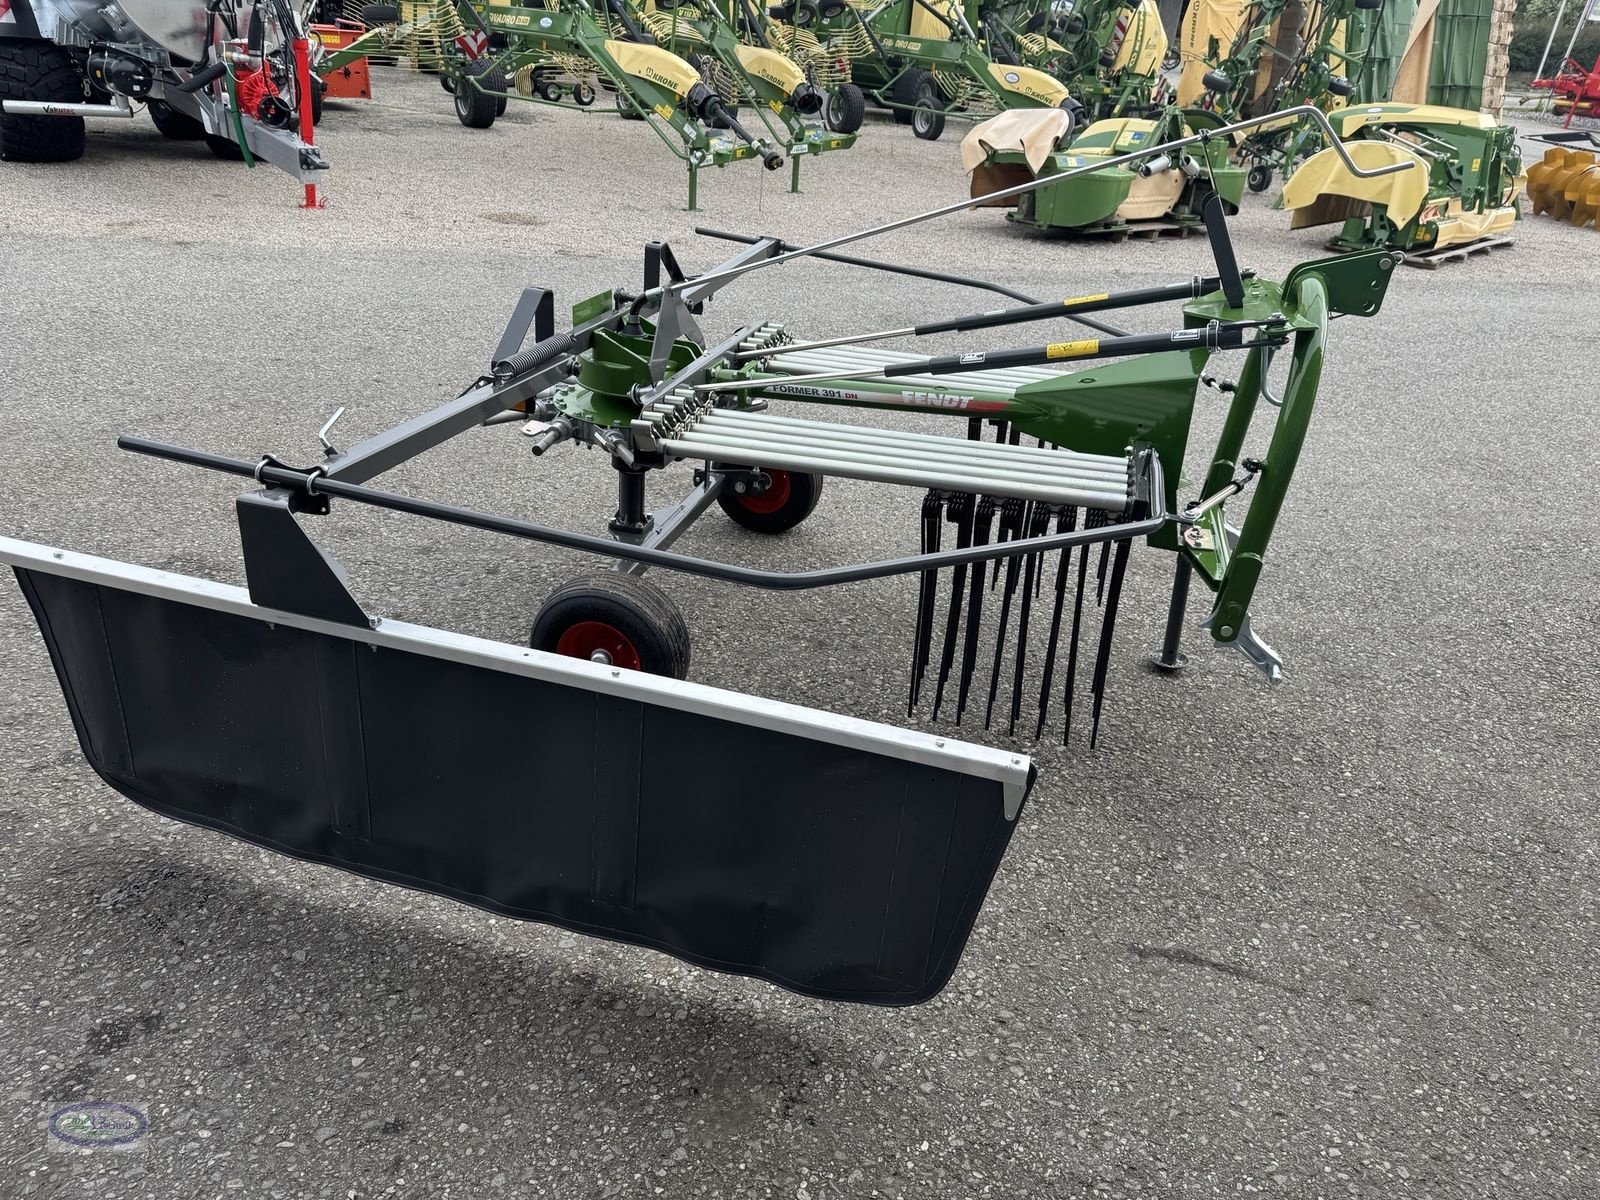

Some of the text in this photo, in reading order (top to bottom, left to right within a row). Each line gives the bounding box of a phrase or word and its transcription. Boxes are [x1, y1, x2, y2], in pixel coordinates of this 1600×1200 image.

[1189, 12, 1198, 48] KRONE
[652, 73, 679, 90] KRONE
[765, 73, 786, 88] KRONE
[1031, 92, 1054, 105] KRONE
[772, 385, 820, 396] FORMER
[822, 389, 842, 398] 391
[902, 391, 974, 408] FENDT
